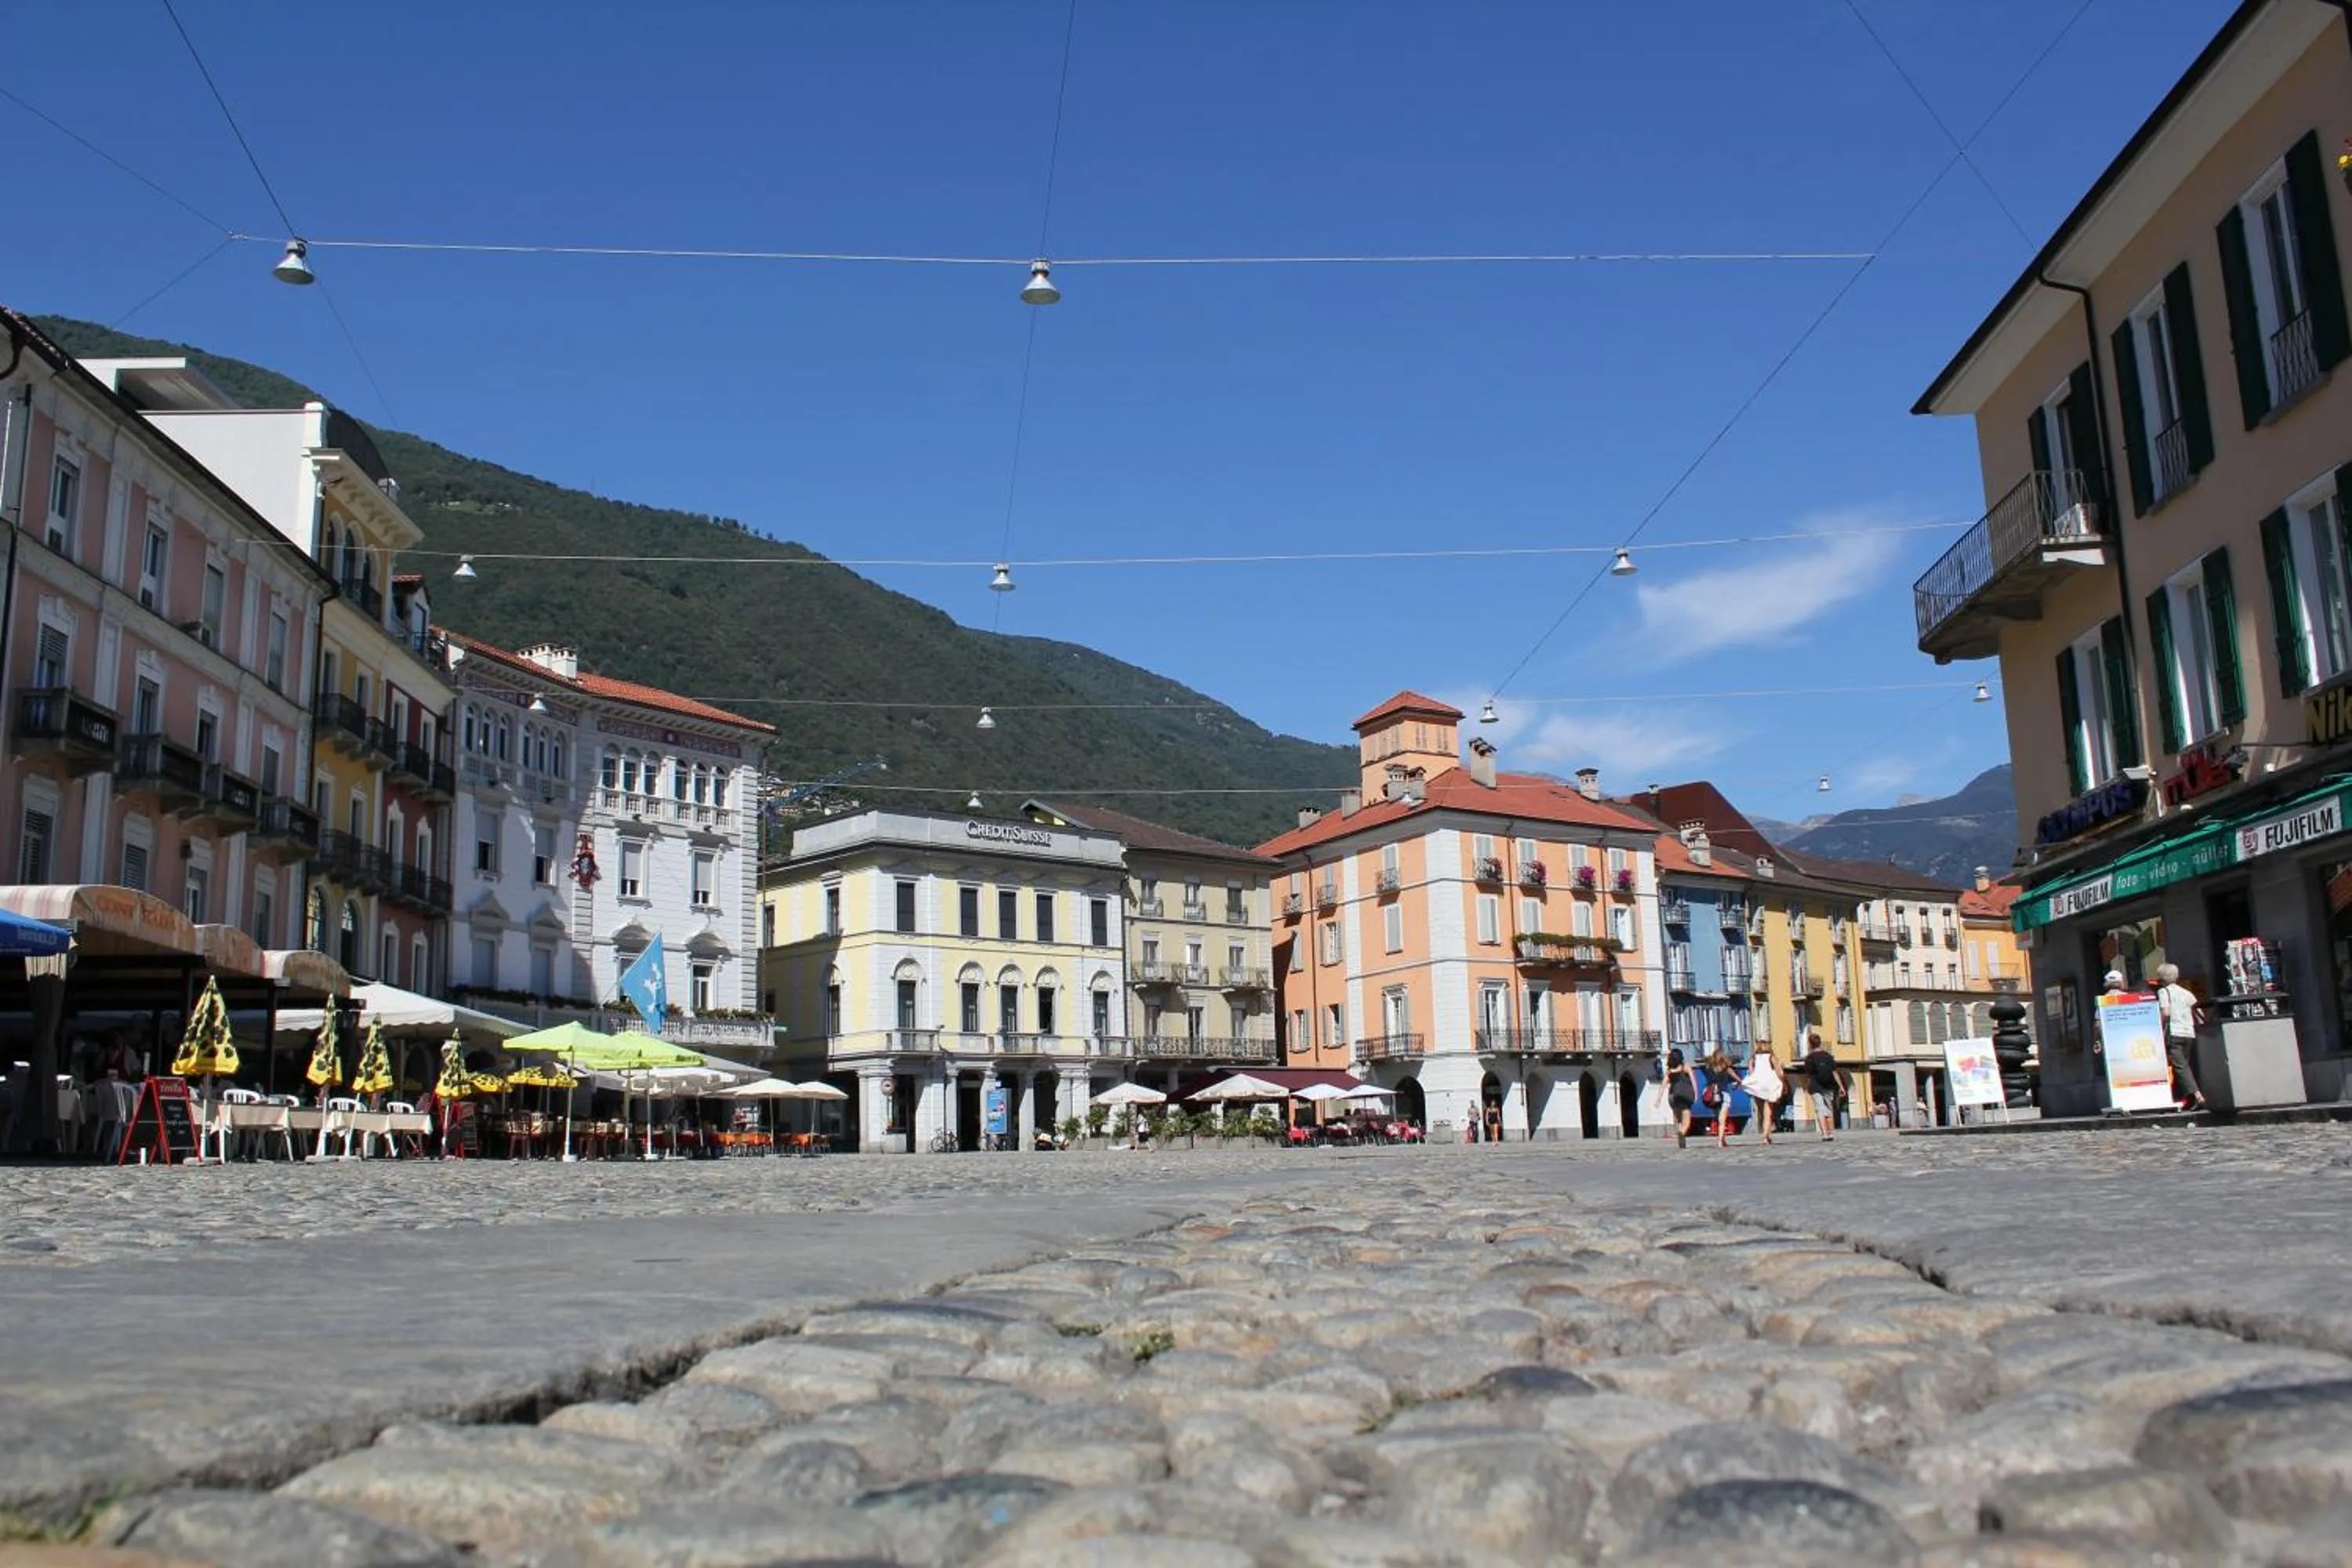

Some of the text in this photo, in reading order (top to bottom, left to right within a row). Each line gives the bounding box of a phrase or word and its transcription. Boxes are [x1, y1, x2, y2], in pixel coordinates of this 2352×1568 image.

[966, 819, 1052, 844] CREDIT SUISSE
[2265, 808, 2333, 849] FUJIFILM
[2067, 881, 2108, 912] FUJIFILM
[2116, 874, 2138, 891] foto
